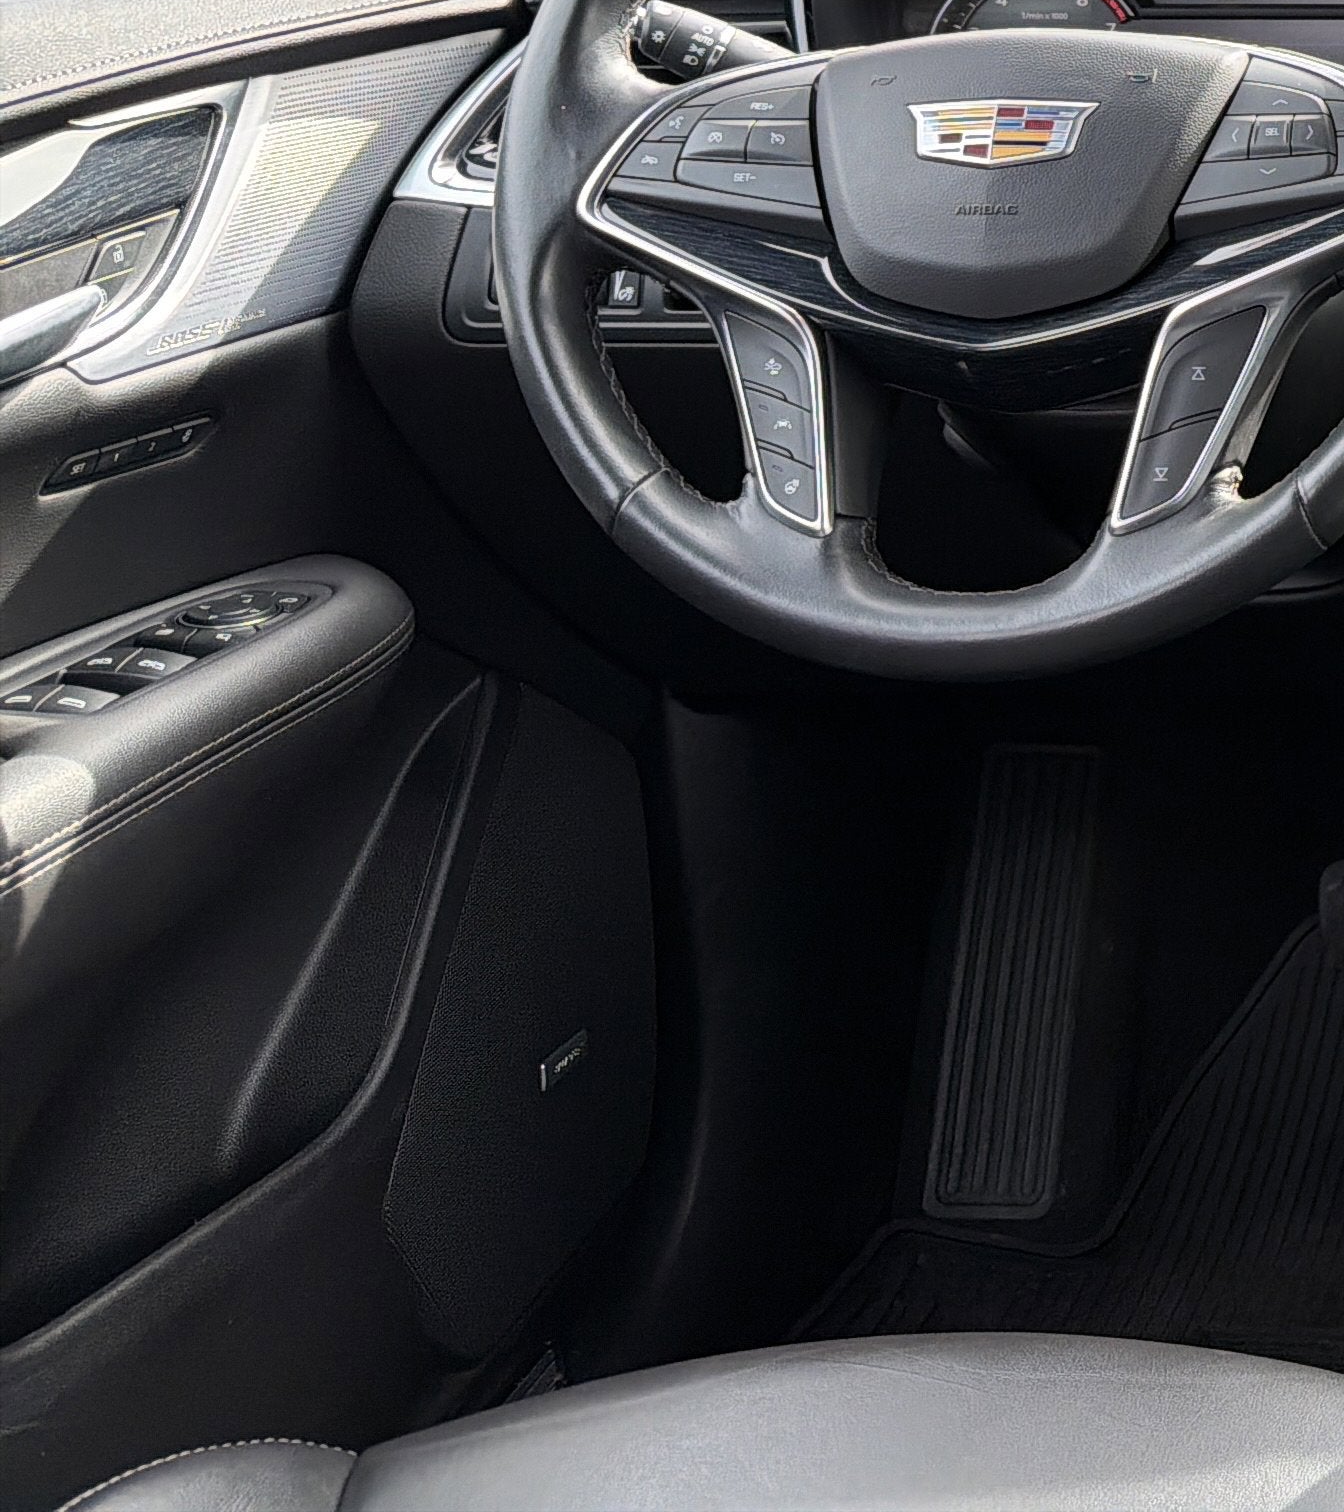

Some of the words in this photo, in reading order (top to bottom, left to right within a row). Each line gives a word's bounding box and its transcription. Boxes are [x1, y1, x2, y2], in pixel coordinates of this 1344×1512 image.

[691, 32, 715, 46] AUTO
[1265, 128, 1279, 136] SEL
[955, 203, 1019, 216] AIRBAG
